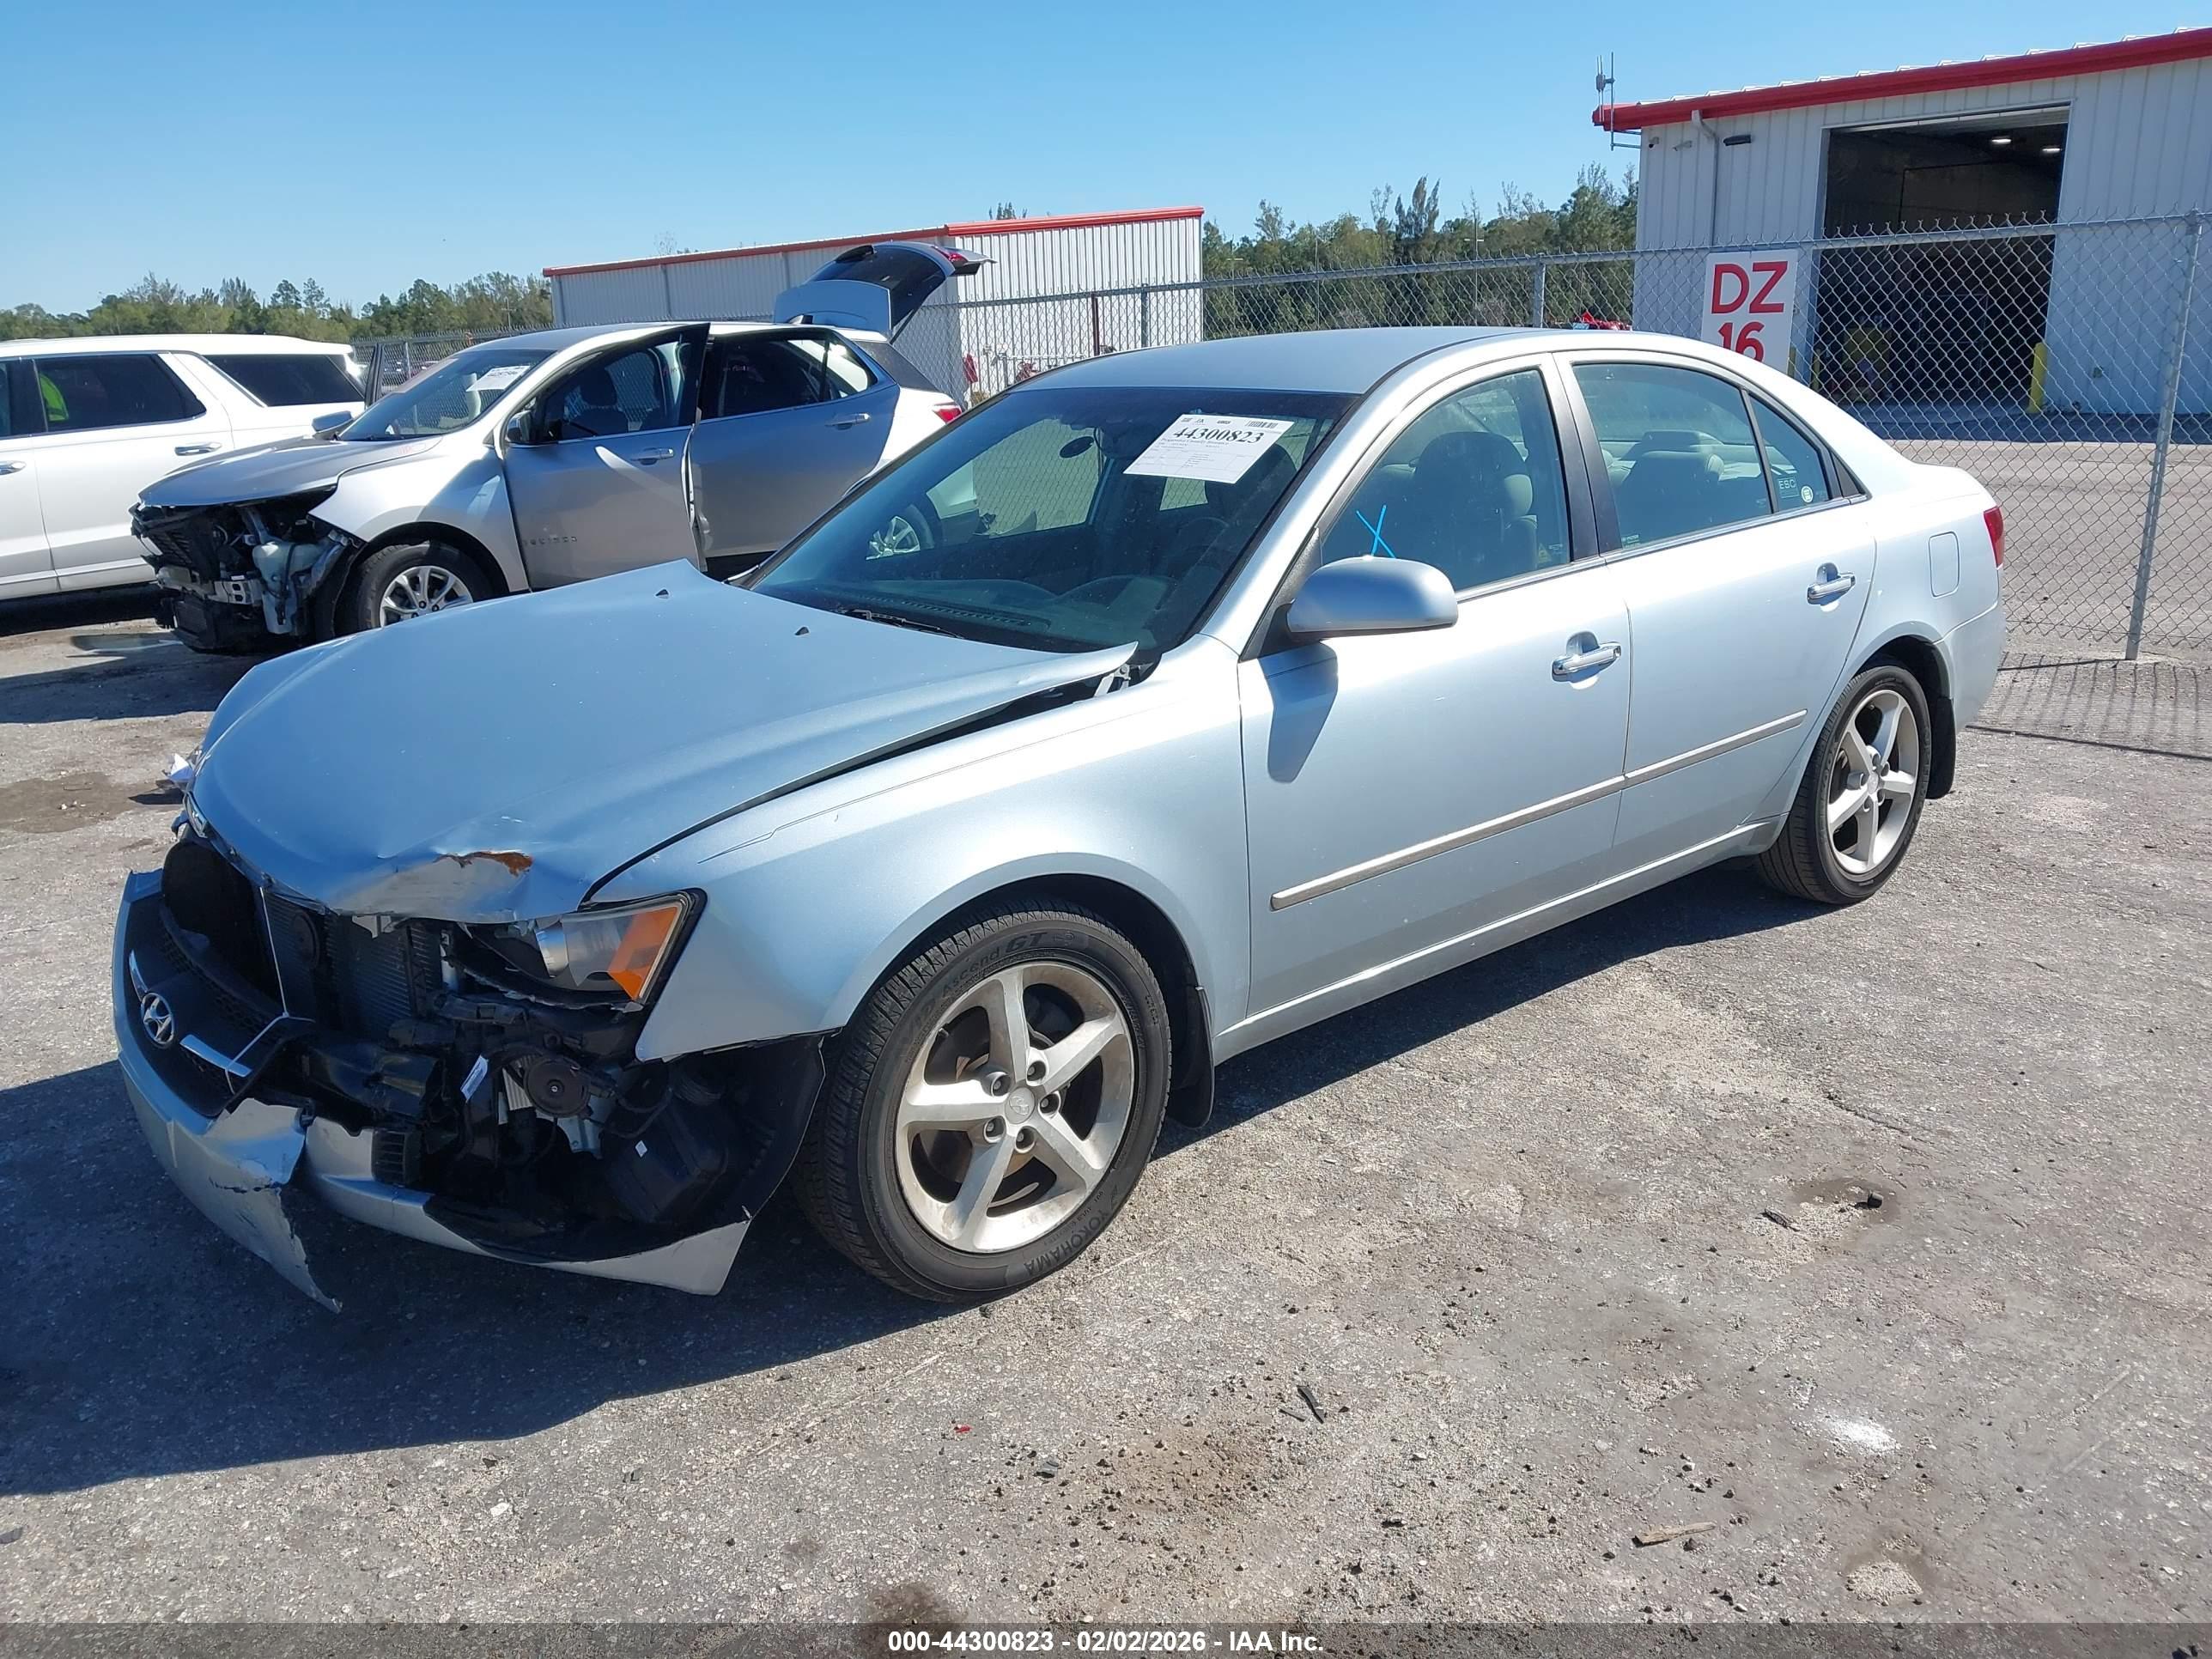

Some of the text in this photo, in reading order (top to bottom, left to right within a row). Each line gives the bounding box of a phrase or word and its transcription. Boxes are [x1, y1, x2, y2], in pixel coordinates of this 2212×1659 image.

[1711, 261, 1788, 313] DZ
[1718, 322, 1765, 362] 16
[1173, 427, 1265, 444] 44300823
[1778, 479, 1797, 489] ESC
[940, 946, 1000, 997] Ascend
[1006, 932, 1048, 953] GT
[1024, 1209, 1111, 1276] YOKOHAMA
